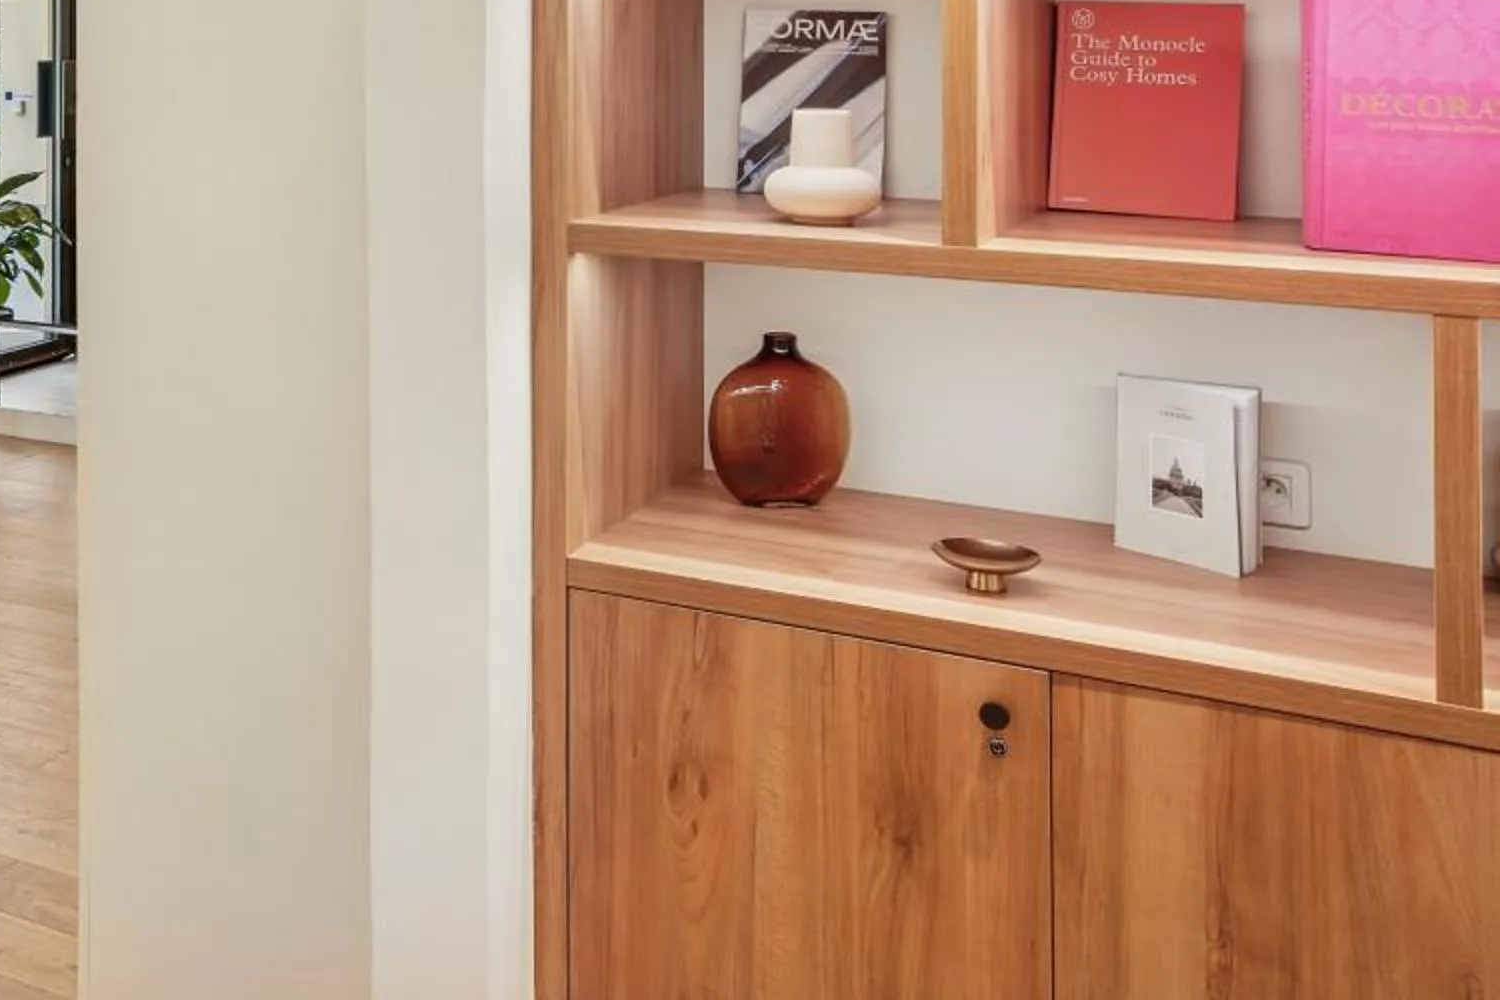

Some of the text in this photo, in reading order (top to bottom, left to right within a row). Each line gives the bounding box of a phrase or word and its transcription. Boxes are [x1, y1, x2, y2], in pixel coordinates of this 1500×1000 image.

[769, 18, 879, 42] ORMÆ
[1070, 33, 1206, 53] The Monocle
[1070, 49, 1158, 67] Guide to
[1069, 65, 1198, 86] Cosy Homes
